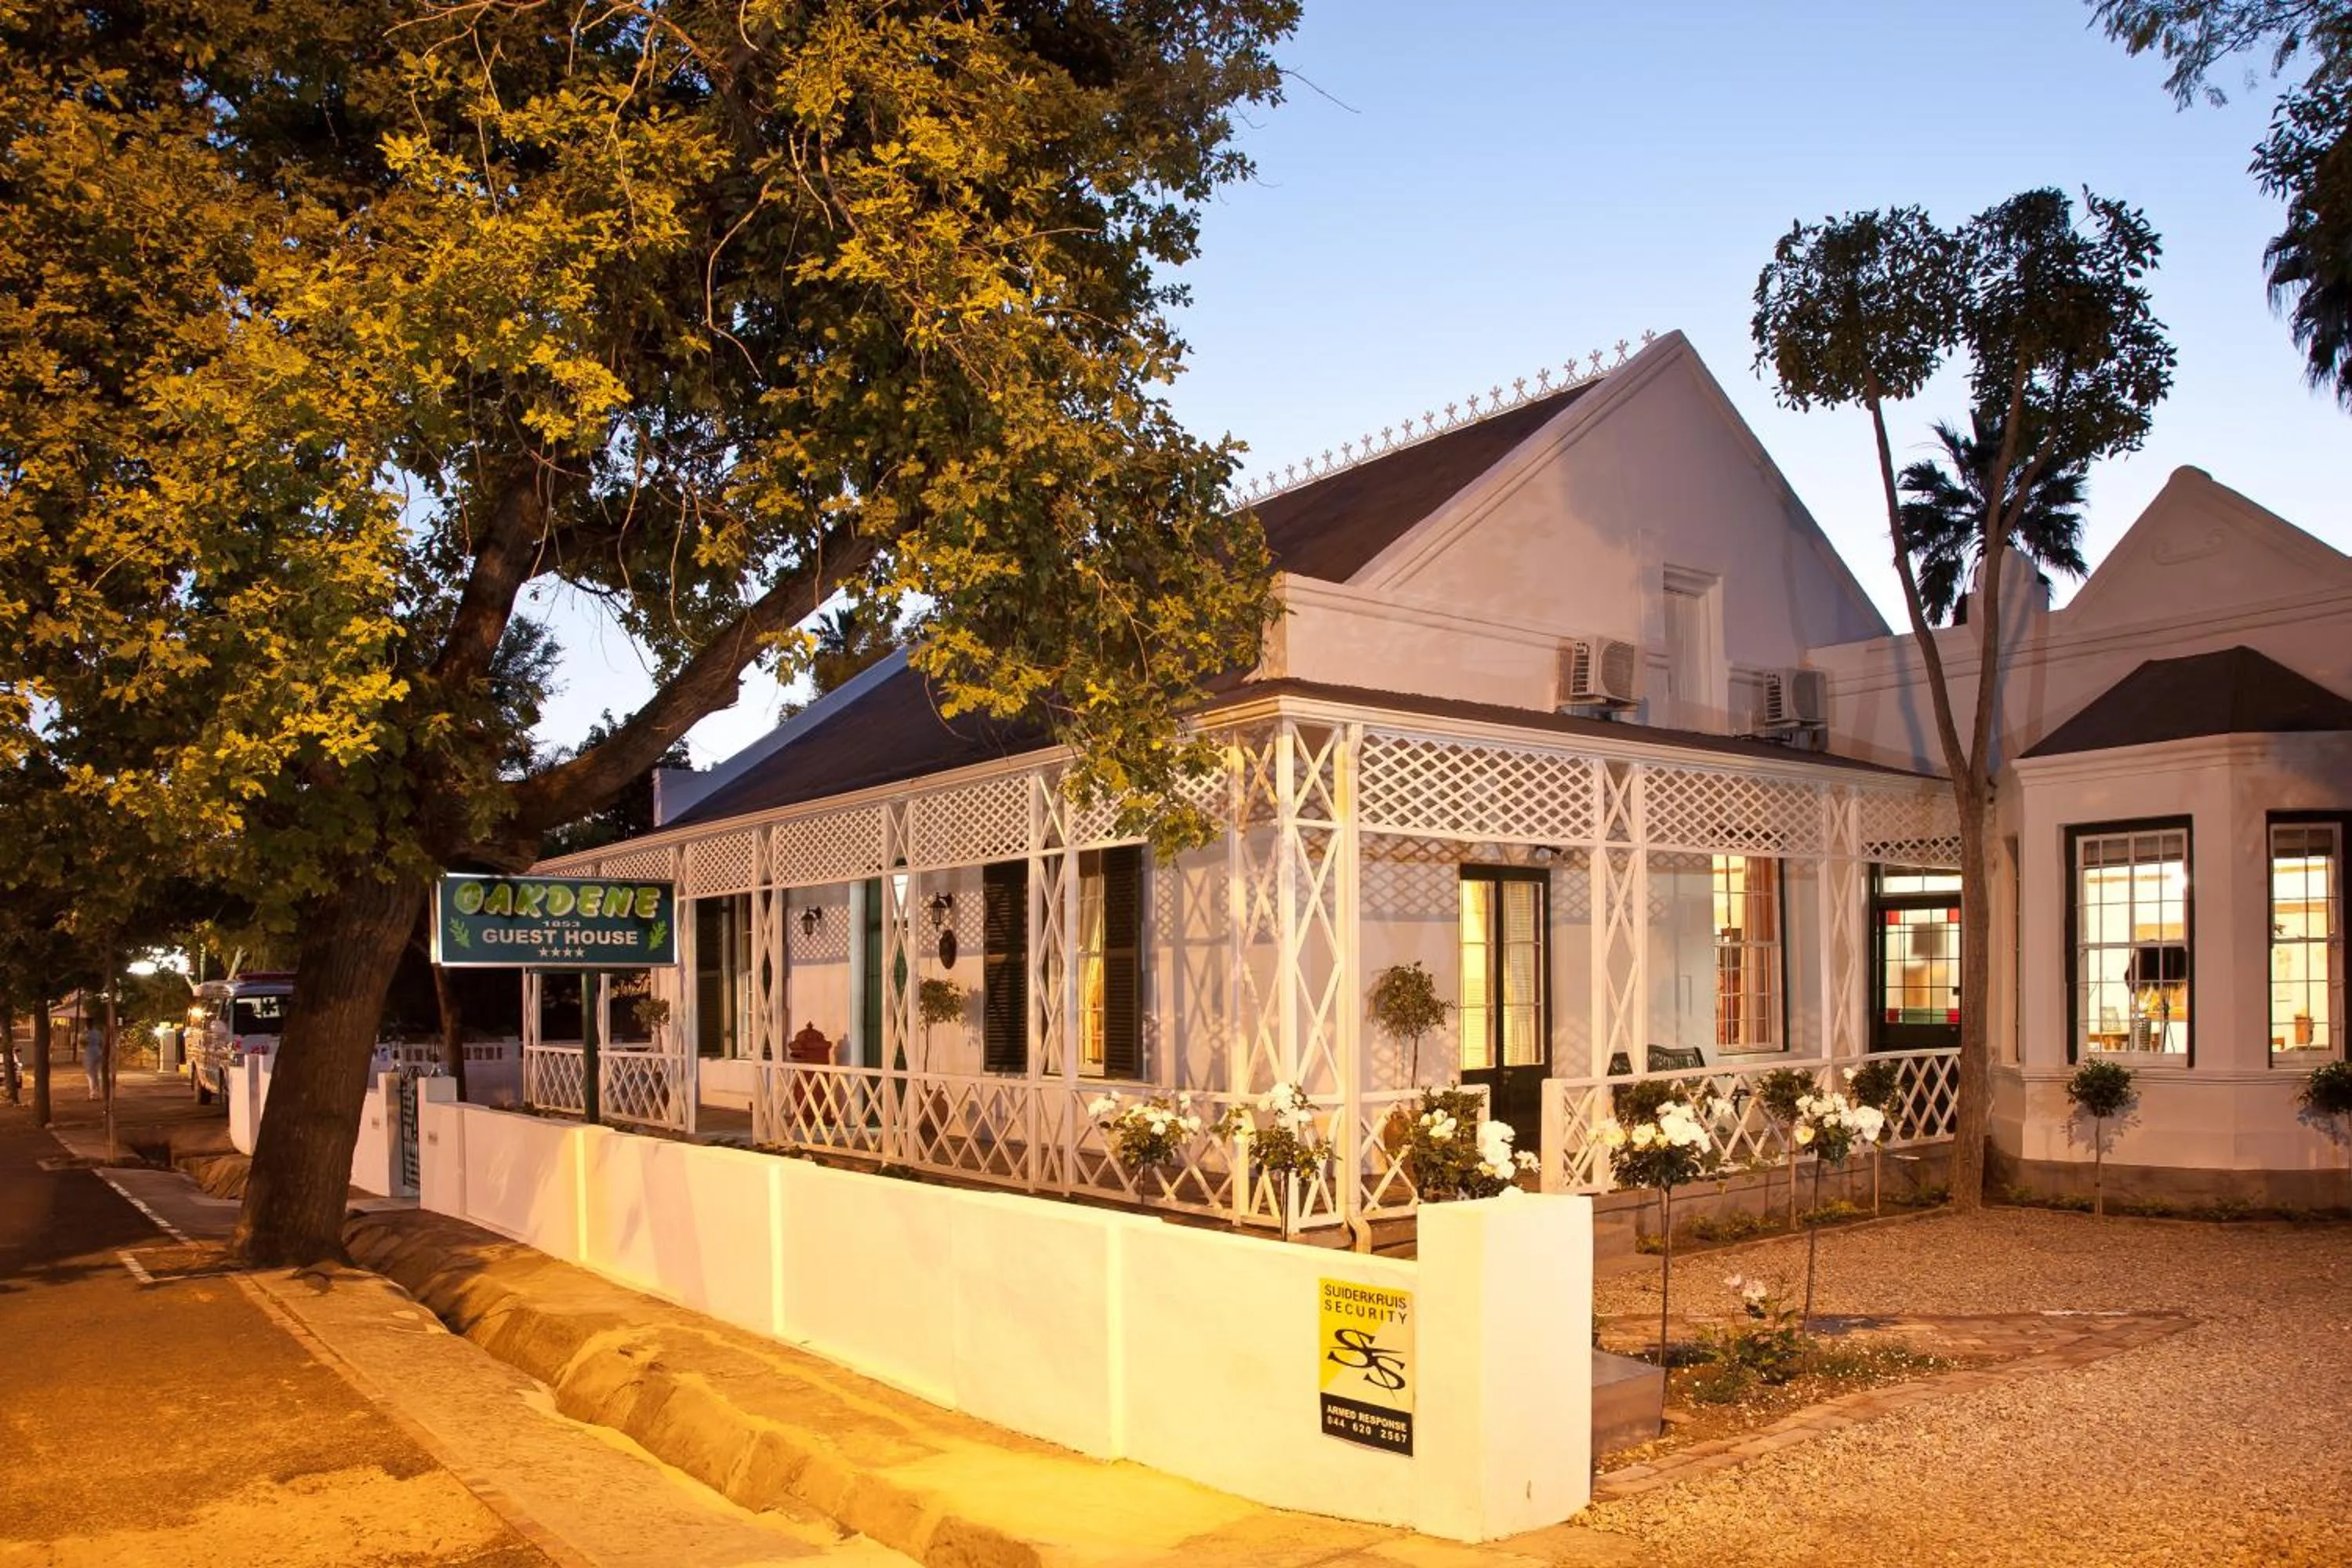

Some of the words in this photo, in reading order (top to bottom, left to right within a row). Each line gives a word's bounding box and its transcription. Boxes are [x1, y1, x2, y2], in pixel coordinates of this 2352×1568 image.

[454, 881, 660, 918] OAKDENE
[482, 928, 557, 944] GUEST
[564, 930, 638, 945] HOUSE
[1324, 1283, 1407, 1309] SUIDERKRUIS
[1324, 1299, 1407, 1325] SECURITY
[1327, 1404, 1356, 1420] ARMED
[1358, 1412, 1406, 1432] RESPONSE
